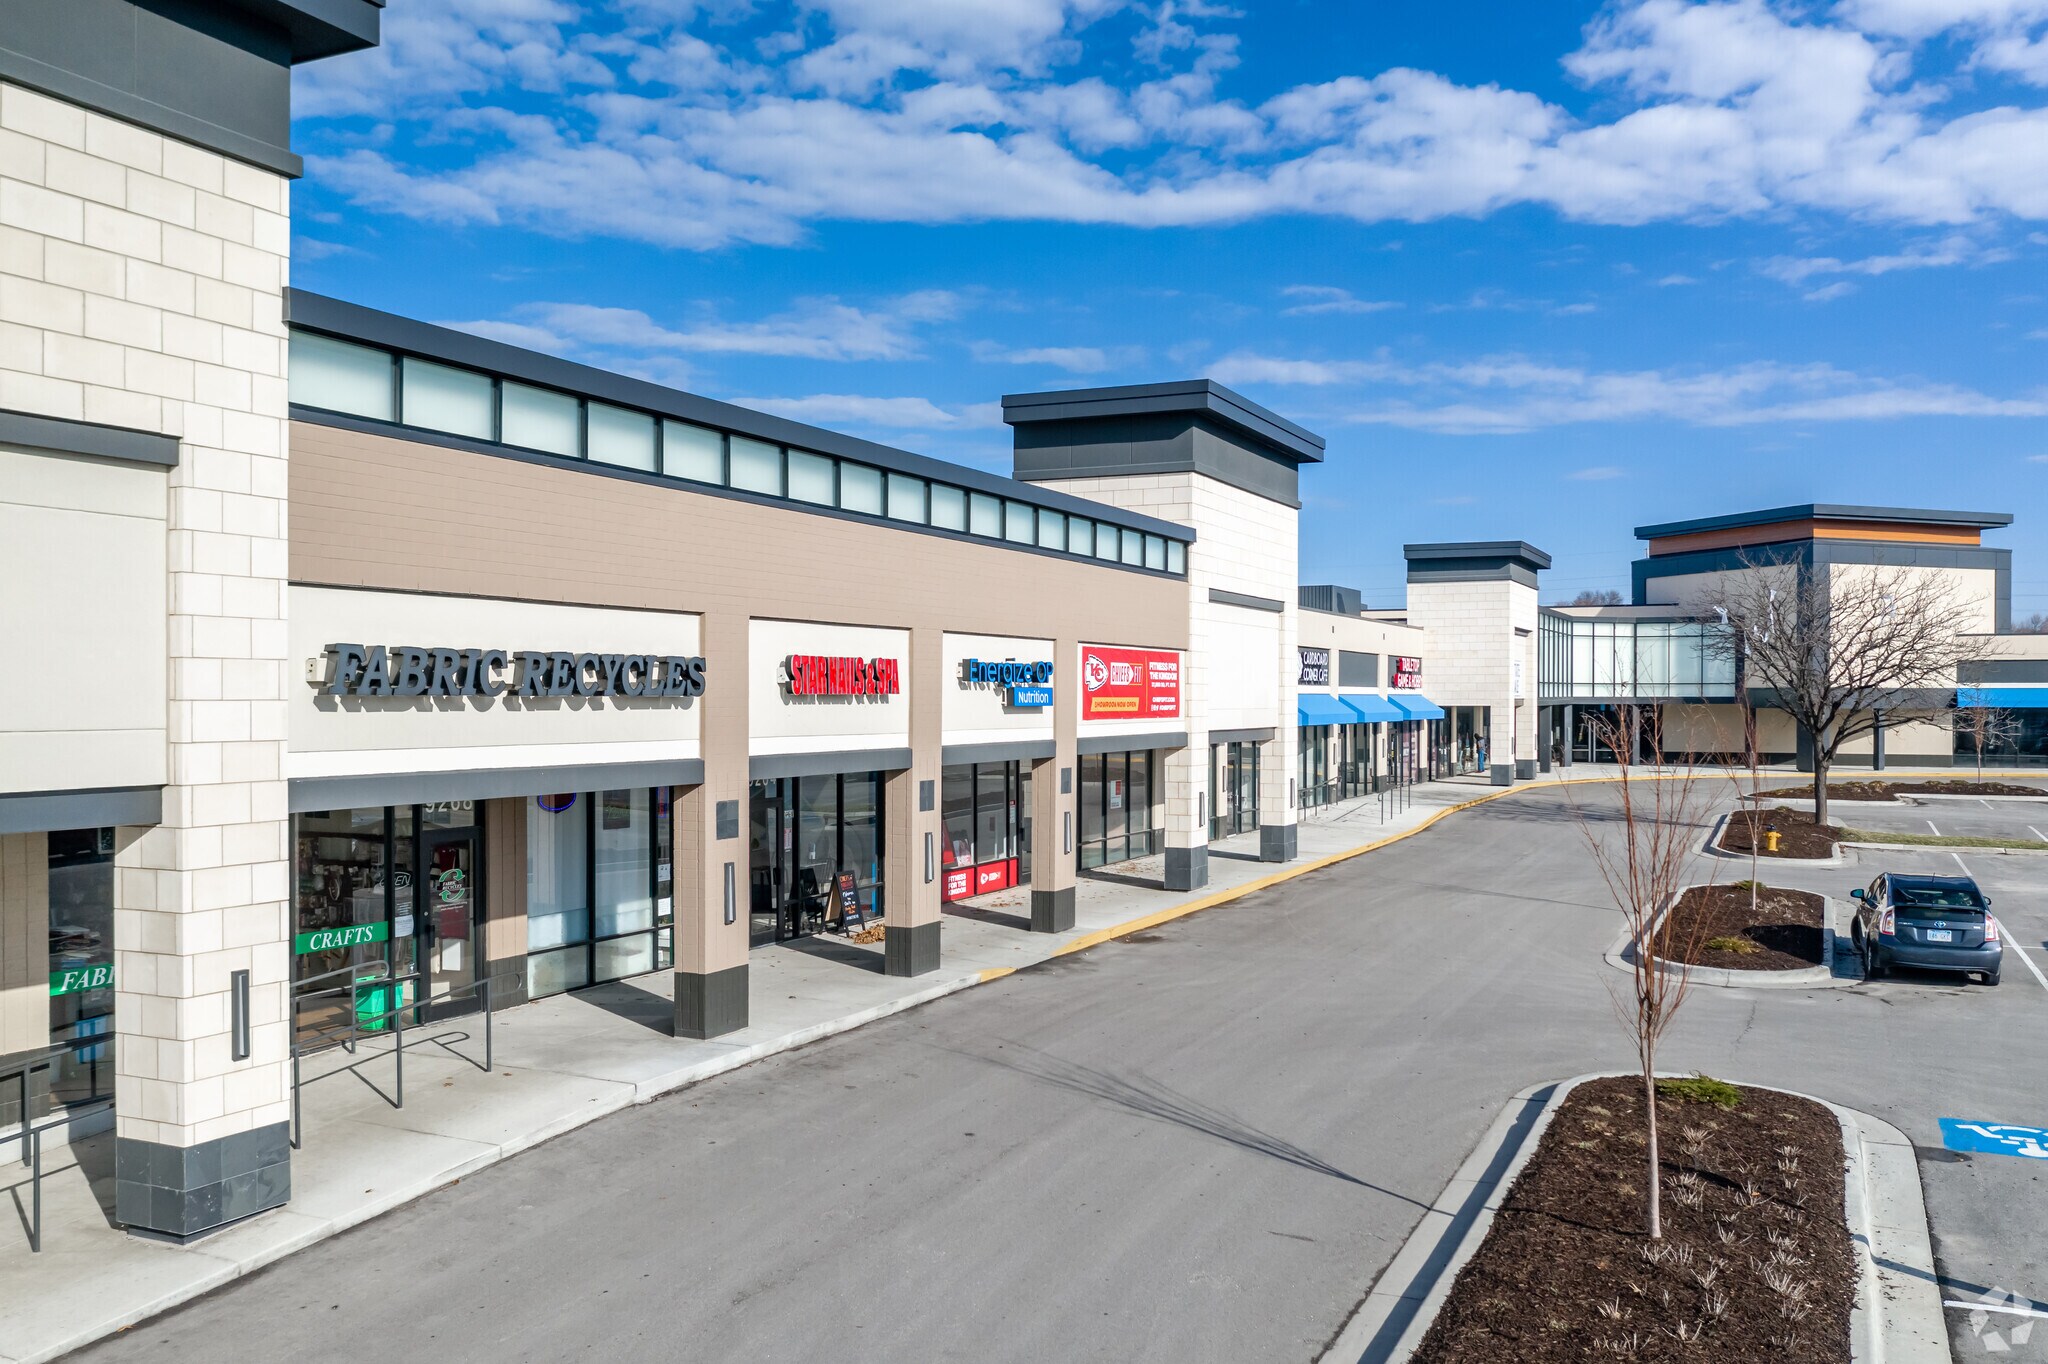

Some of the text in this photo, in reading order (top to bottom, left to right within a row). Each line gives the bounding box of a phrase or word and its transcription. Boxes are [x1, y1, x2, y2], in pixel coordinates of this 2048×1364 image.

[1303, 651, 1329, 666] CARDBOARD
[1401, 657, 1420, 673] TABLETOP
[326, 644, 707, 697] FABRIC RECYCLES
[791, 654, 900, 695] STAR NAILS & SPA
[969, 658, 1054, 688] Energize OP
[1111, 665, 1131, 683] CHIEFS
[1303, 668, 1318, 682] CORNER
[1397, 673, 1409, 688] GAME
[1018, 690, 1049, 703] Nutrition
[310, 926, 373, 950] CRAFTS
